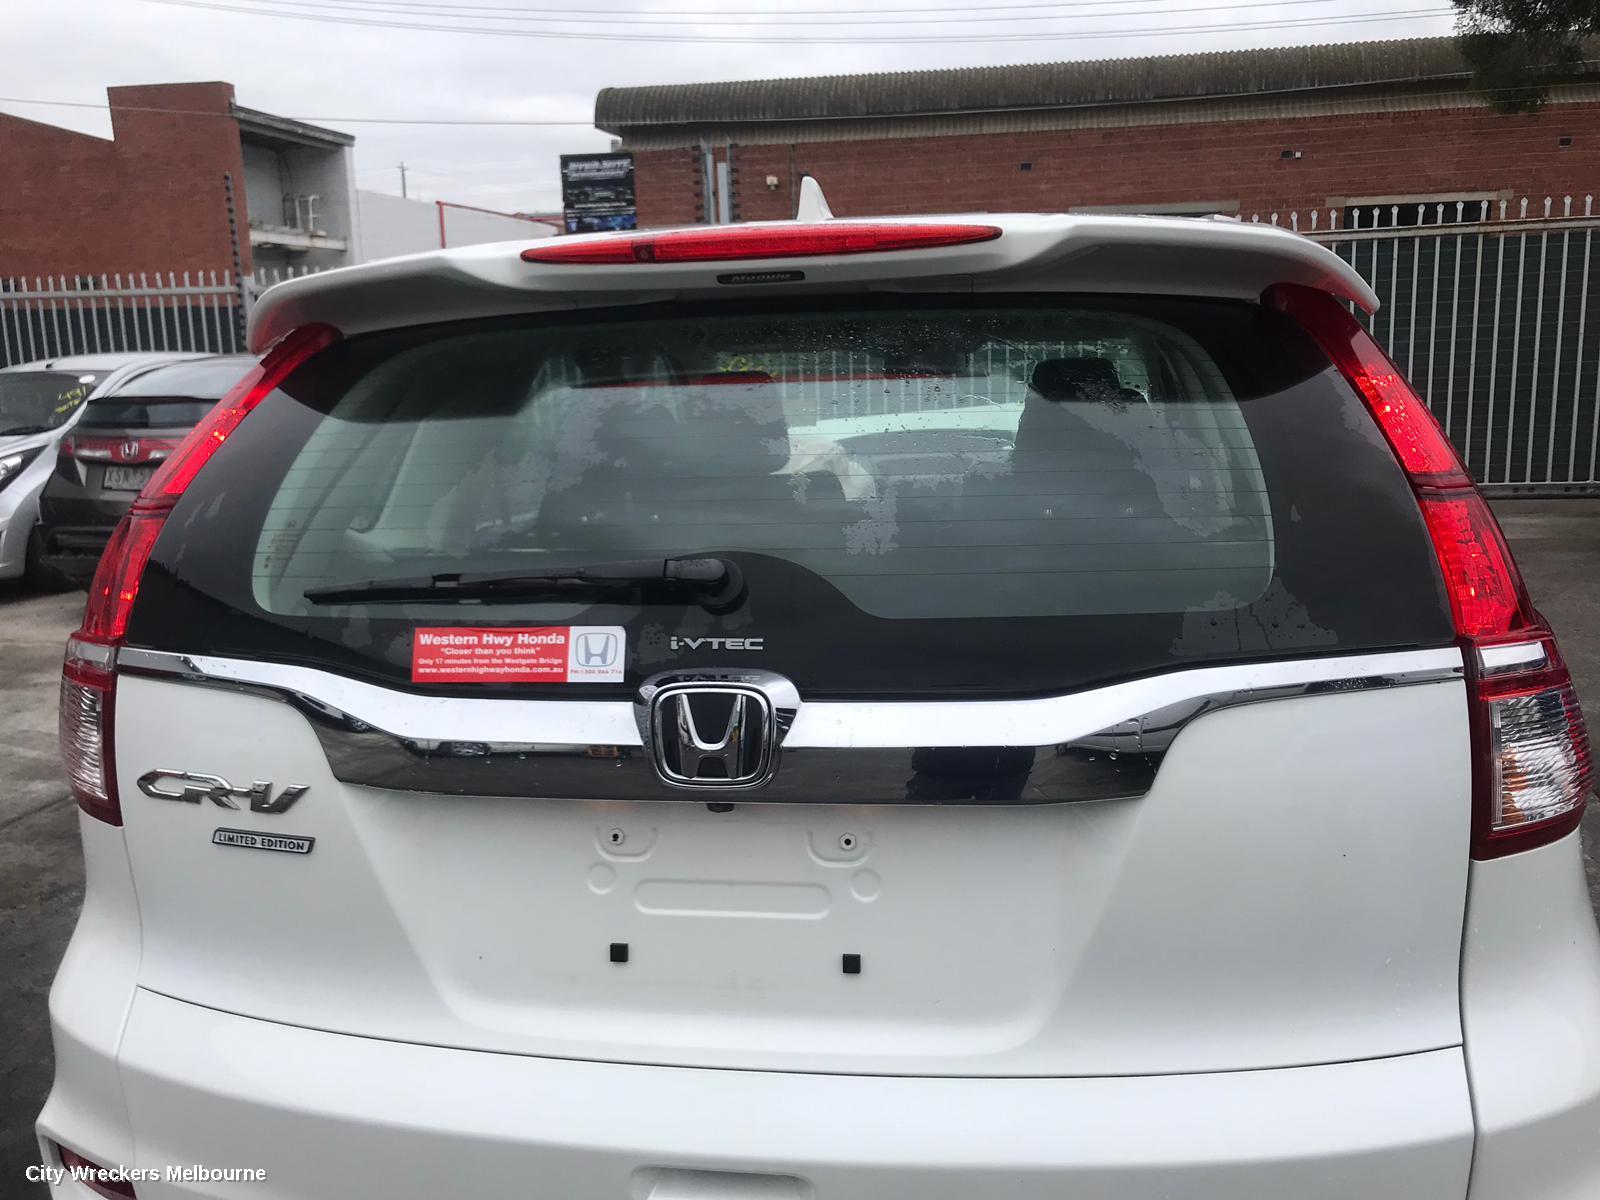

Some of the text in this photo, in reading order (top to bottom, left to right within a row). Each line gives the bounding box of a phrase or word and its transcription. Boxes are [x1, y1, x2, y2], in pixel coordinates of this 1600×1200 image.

[419, 632, 566, 647] Western Hwy Honda
[670, 636, 764, 650] i-VTEC
[475, 647, 494, 655] than
[496, 647, 513, 656] you
[504, 657, 538, 665] Westgate
[539, 656, 564, 665] Bridge
[418, 666, 564, 674] www.westernhighwayhonda.com.au
[137, 768, 311, 814] CR-V
[218, 832, 305, 851] LIMITED EDITION
